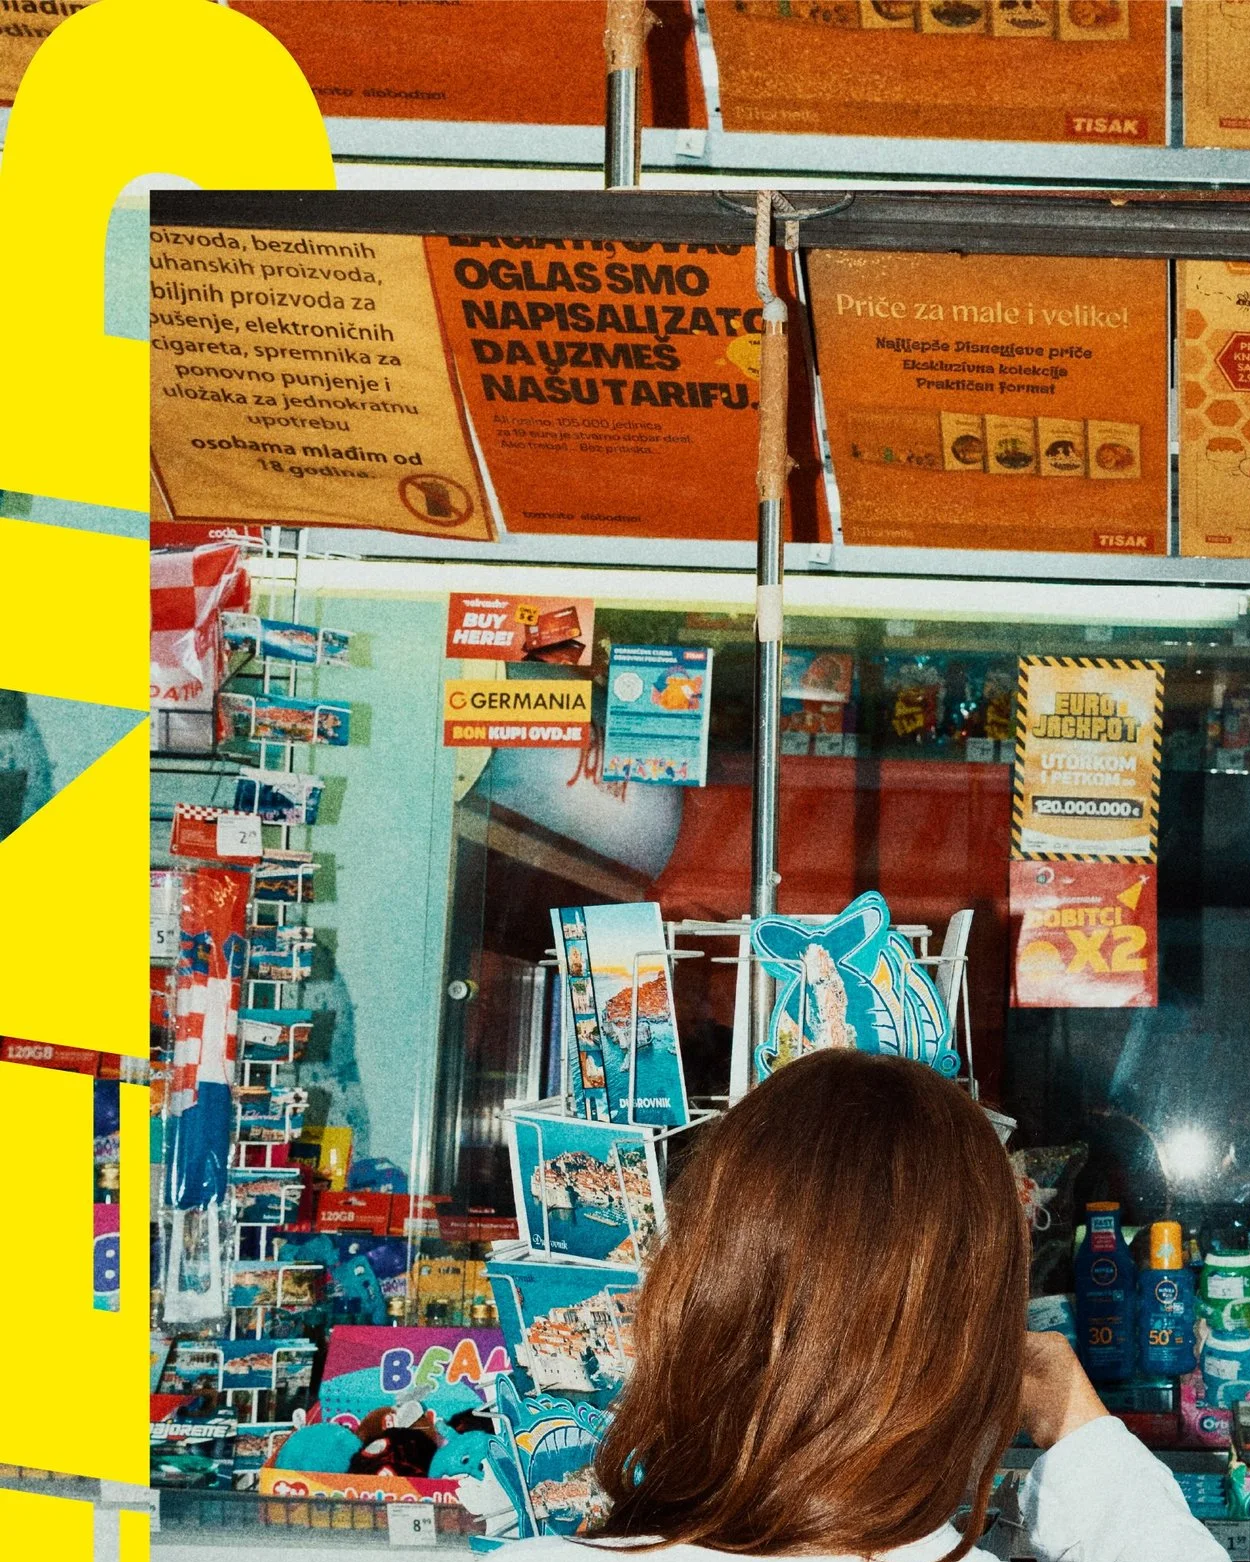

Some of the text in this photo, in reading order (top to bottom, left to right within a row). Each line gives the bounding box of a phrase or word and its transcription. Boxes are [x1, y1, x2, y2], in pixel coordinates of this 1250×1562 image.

[1073, 117, 1139, 135] TISAK
[251, 235, 376, 259] bezdimnih
[261, 262, 383, 286] proizvoda,
[453, 257, 710, 297] OGLAS SMO
[151, 281, 376, 311] biljnih proizvoda za
[461, 299, 657, 335] NAPISALI
[836, 293, 1130, 329] Priče za male i velike!
[245, 317, 395, 342] elektroničnih
[151, 335, 402, 367] cigareta, spremnika za
[470, 334, 681, 372] DA UZMEŠ
[876, 336, 950, 354] Najljepše
[1048, 343, 1093, 360] priče
[175, 362, 391, 394] ponovno punjenje i
[902, 359, 1068, 380] Ekskluzivna kolekcija
[480, 367, 599, 405] NAŠU
[916, 377, 1056, 396] Praktičan format
[163, 384, 419, 416] uložaka za jednokratnu
[247, 413, 350, 432] upotrebu
[191, 435, 423, 467] osobama mlađim od
[257, 457, 285, 473] 18
[1098, 533, 1148, 549] TISAK
[462, 613, 507, 629] BUY
[453, 630, 514, 646] HERE!
[471, 692, 587, 710] GERMANIA
[453, 726, 583, 742] BON KUPI OVDJE
[1032, 715, 1141, 743] JACKPOT
[1041, 754, 1137, 773] UTORKOM
[1051, 771, 1121, 786] PETKOM
[321, 1210, 355, 1222] 120GB
[1089, 1327, 1113, 1346] 30
